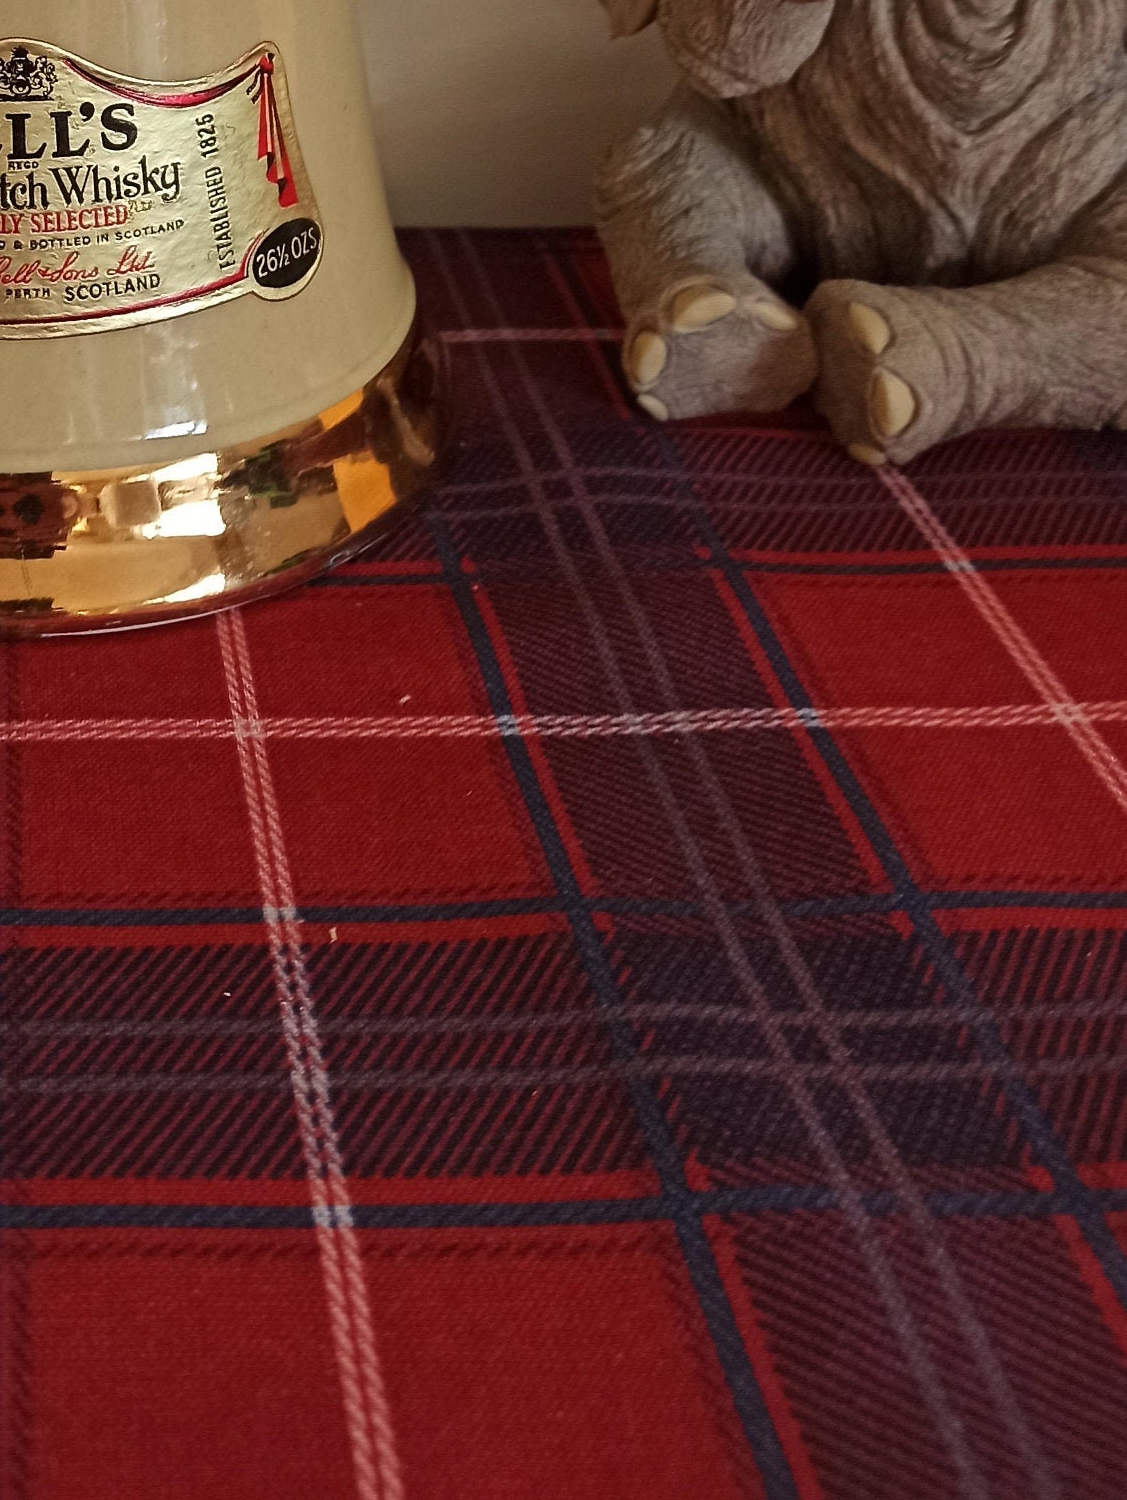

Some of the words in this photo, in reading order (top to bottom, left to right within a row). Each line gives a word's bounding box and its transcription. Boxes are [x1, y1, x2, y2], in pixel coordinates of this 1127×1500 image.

[195, 113, 219, 159] 1825
[50, 155, 180, 202] Whisky
[13, 241, 23, 250] &
[29, 235, 91, 250] BOTTLED
[96, 233, 109, 243] IN
[115, 218, 185, 239] SCOTLAND
[31, 204, 129, 233] SELECTED
[205, 166, 235, 269] ESTABLISHED
[291, 226, 317, 259] OZS
[48, 250, 99, 283] Sons
[5, 287, 51, 299] PERTH
[64, 273, 161, 302] SCOTLAND
